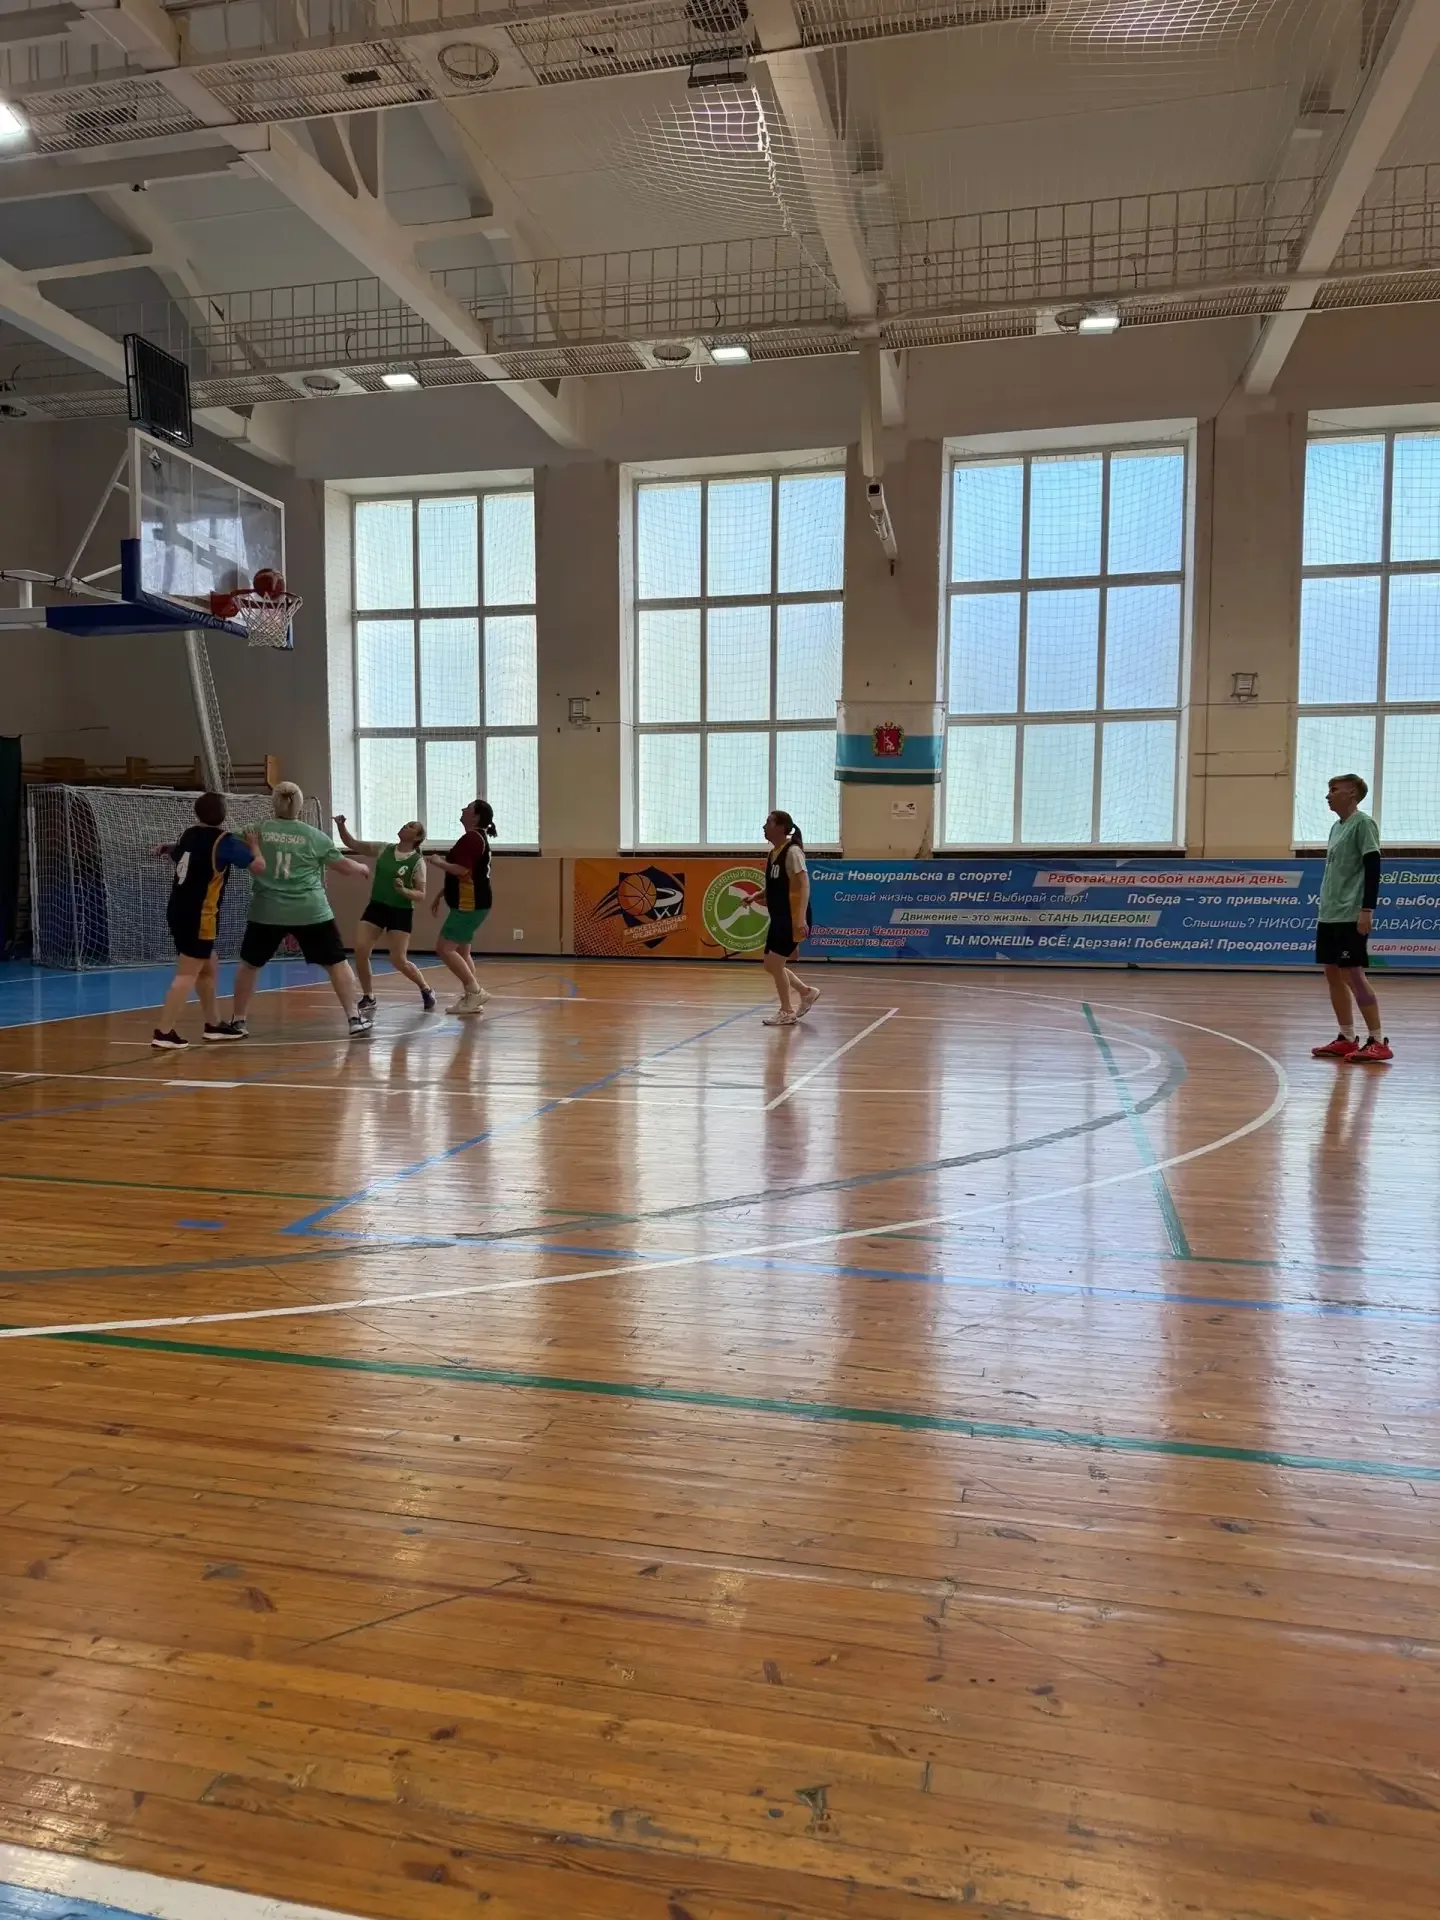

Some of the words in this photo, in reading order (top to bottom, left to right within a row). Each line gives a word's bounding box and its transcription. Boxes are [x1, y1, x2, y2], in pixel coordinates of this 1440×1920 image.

[274, 851, 291, 880] 11
[398, 865, 409, 876] 6
[770, 864, 780, 879] 10
[811, 870, 844, 881] Сила
[847, 870, 943, 883] Новоуральска
[947, 873, 956, 881] в
[959, 870, 1013, 883] спорте!
[1048, 873, 1107, 884] Работай
[1110, 875, 1136, 885] над
[1140, 873, 1184, 884] собой
[1187, 874, 1246, 885] каждый
[1248, 876, 1288, 886] день.
[706, 869, 747, 912] СПОРТИВНЫЙ
[834, 891, 876, 902] Сделай
[879, 893, 914, 902] жизнь
[949, 892, 989, 903] ЯРЧЕ!
[992, 891, 1048, 904] Выбирай
[1050, 892, 1089, 903] спорт!
[1127, 893, 1181, 905] Победа
[1198, 896, 1222, 905] это
[1226, 896, 1301, 907] привычка.
[900, 912, 958, 922] Движение
[993, 914, 1032, 923] жизнь.
[1038, 913, 1079, 923] СТАНЬ
[1081, 914, 1151, 924] ЛИДЕРОМ!
[1182, 917, 1255, 929] Слышишь?
[1257, 918, 1319, 931] НИКОГД
[811, 925, 870, 937] Потенциал
[873, 925, 930, 937] Чемпиона
[811, 938, 817, 946] в
[820, 938, 863, 948] каждом
[866, 938, 880, 947] из
[882, 938, 907, 947] нас!
[945, 935, 965, 946] ТЫ
[968, 935, 1034, 946] МОЖЕШЬ
[1038, 934, 1072, 947] ВСЁ!
[1073, 938, 1131, 949] Дерзай!
[1134, 938, 1214, 951] Побеждай!
[1400, 945, 1436, 953] нормы
